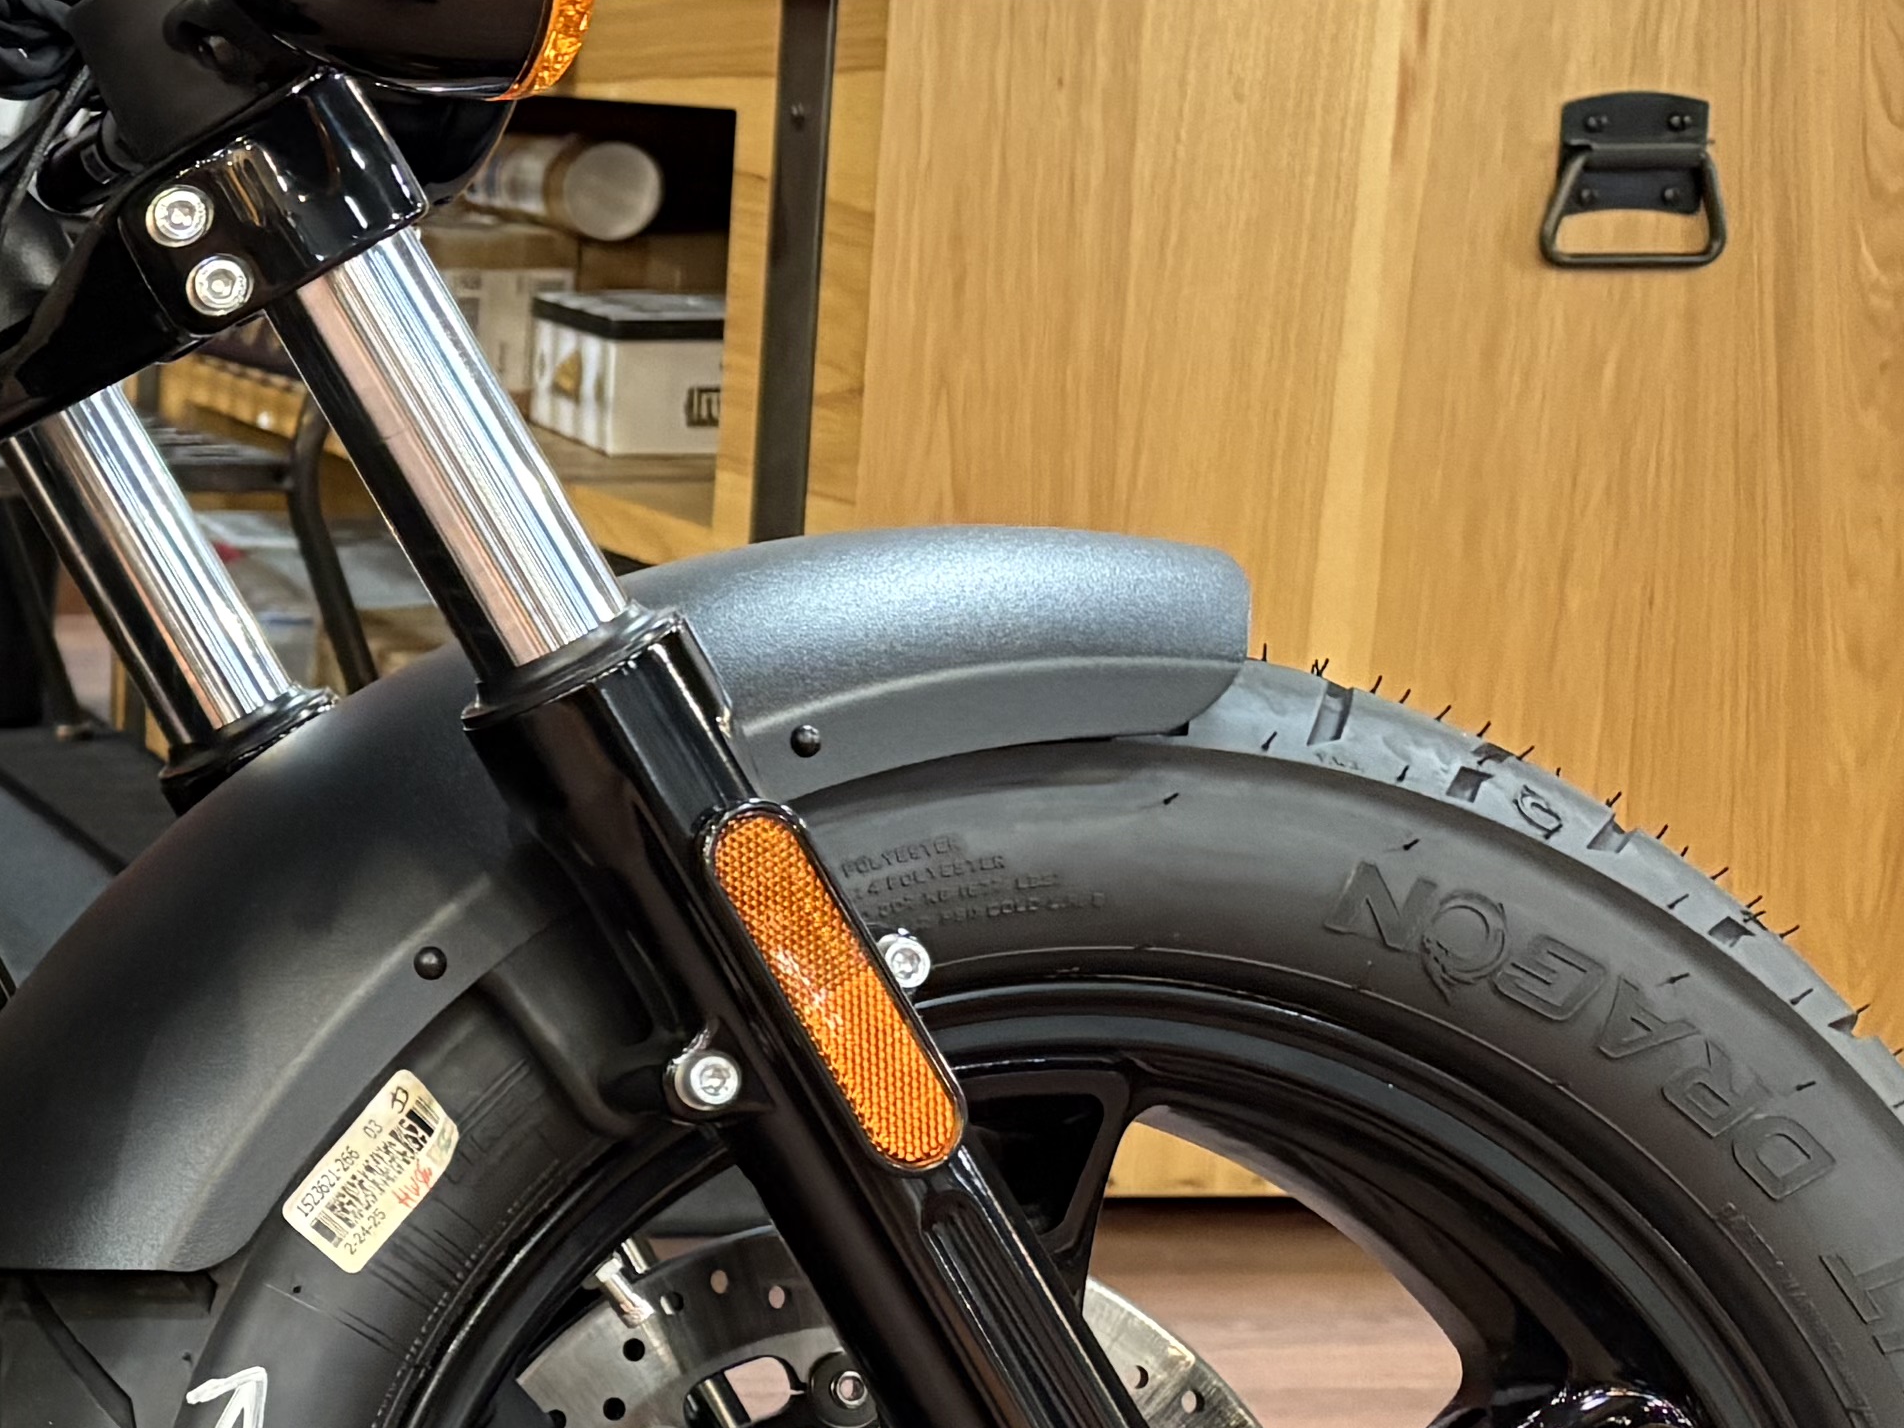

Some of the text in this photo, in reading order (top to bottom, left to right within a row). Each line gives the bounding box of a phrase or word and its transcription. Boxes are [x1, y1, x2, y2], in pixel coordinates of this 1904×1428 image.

[1323, 860, 1838, 1203] DRAGON
[295, 1119, 384, 1220] 1523621-266 03
[344, 1206, 387, 1256] 2-24-25
